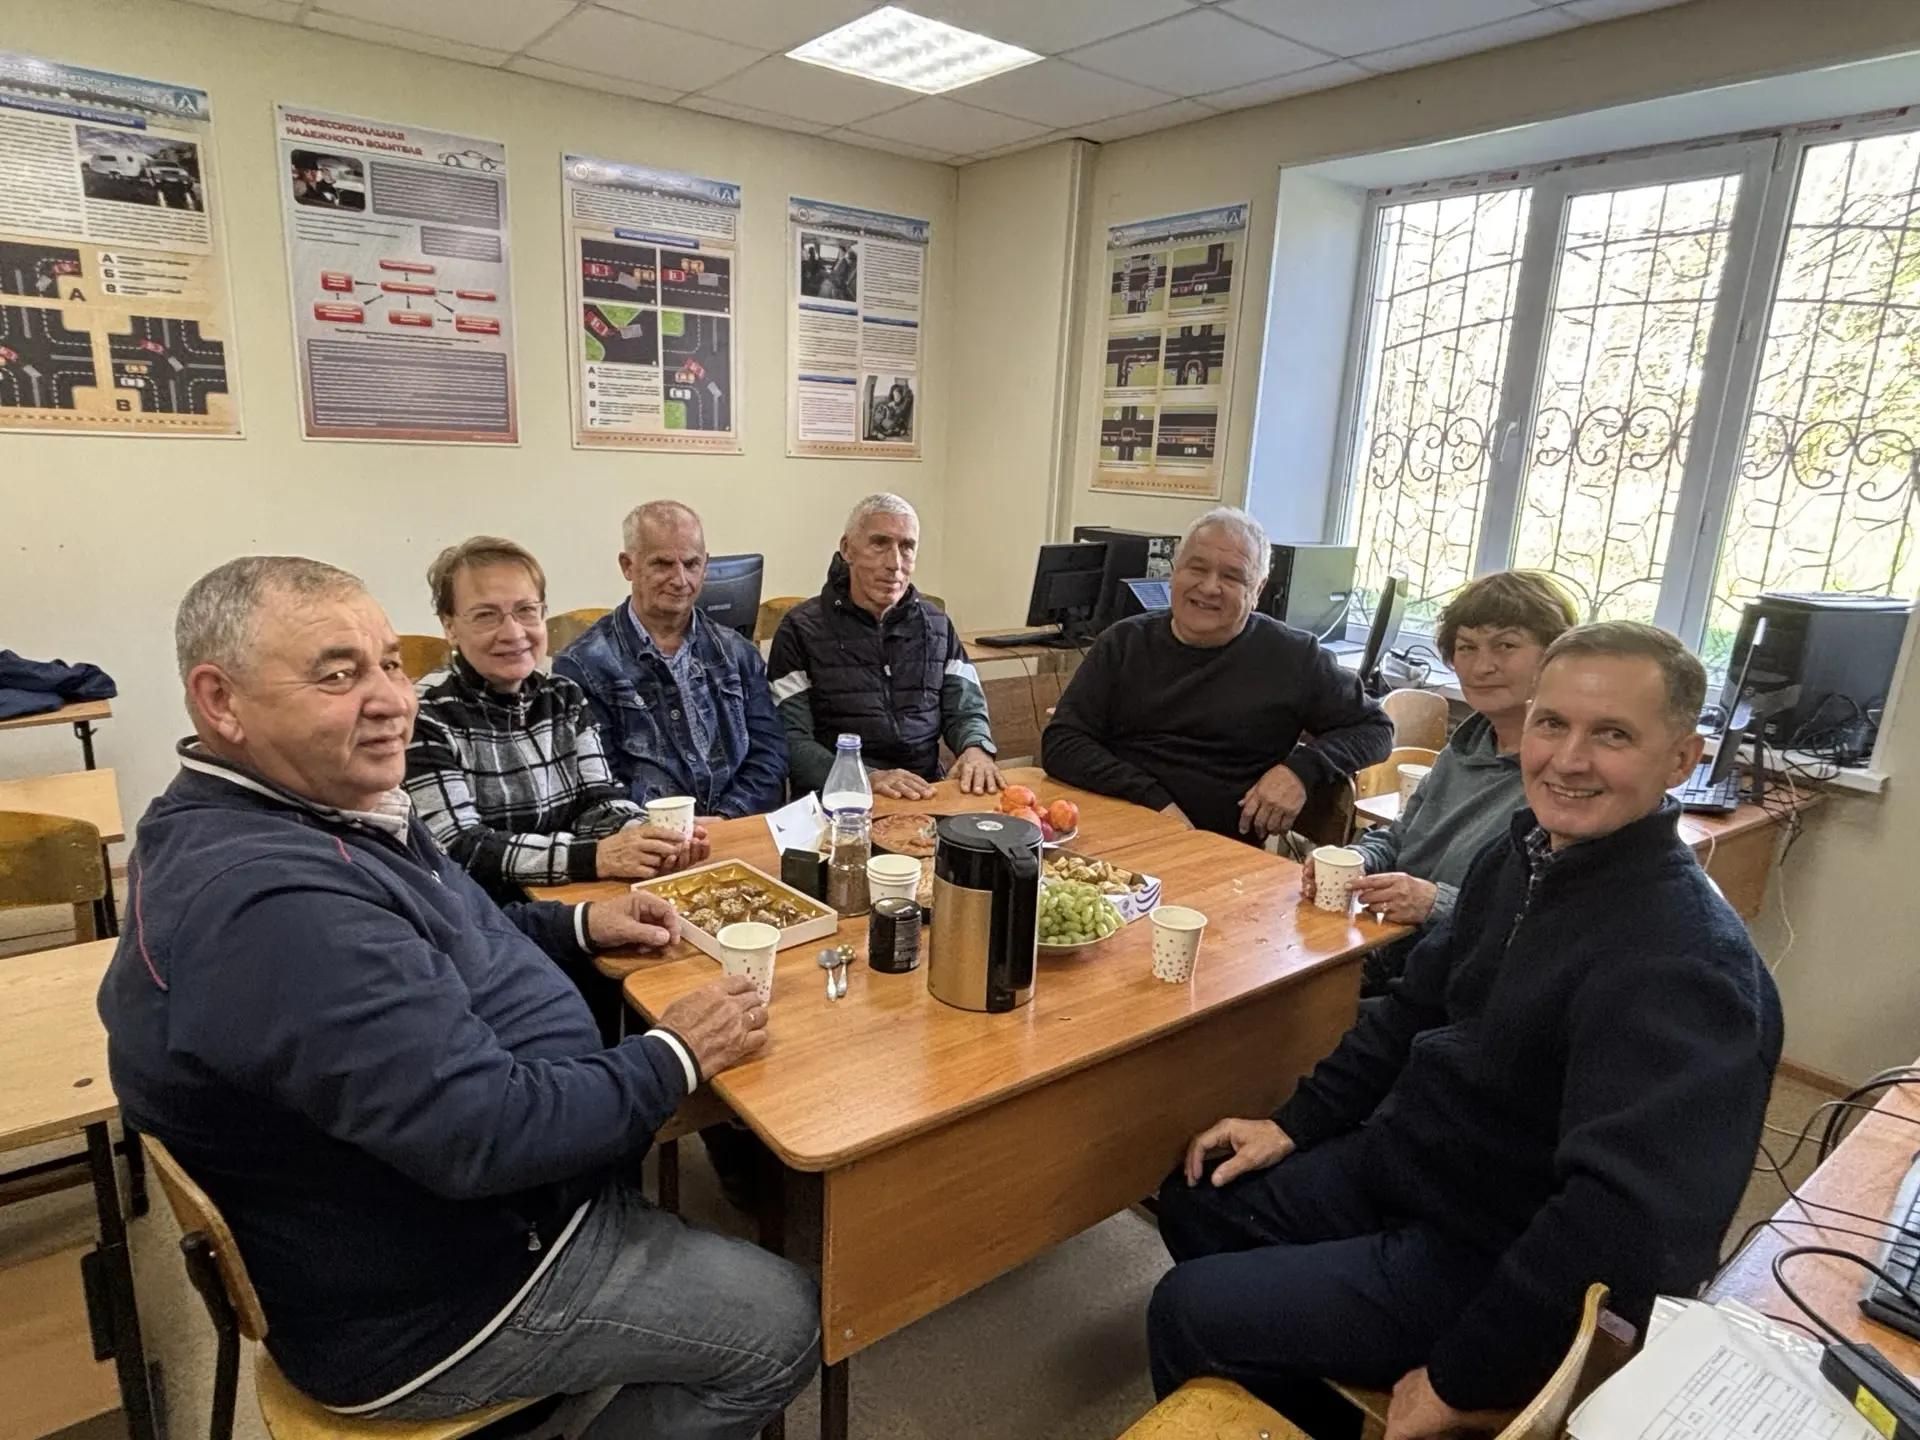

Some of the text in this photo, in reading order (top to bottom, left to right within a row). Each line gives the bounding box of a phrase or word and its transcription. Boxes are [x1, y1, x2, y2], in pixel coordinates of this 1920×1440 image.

[285, 113, 405, 141] ПРОФЕССИОНАЛЬНАЯ
[286, 127, 423, 155] НАДЕЖНОСТЬ ВОДИТЕЛЯ
[102, 253, 114, 264] А
[104, 269, 114, 278] Б
[69, 287, 85, 302] А
[116, 399, 131, 412] В
